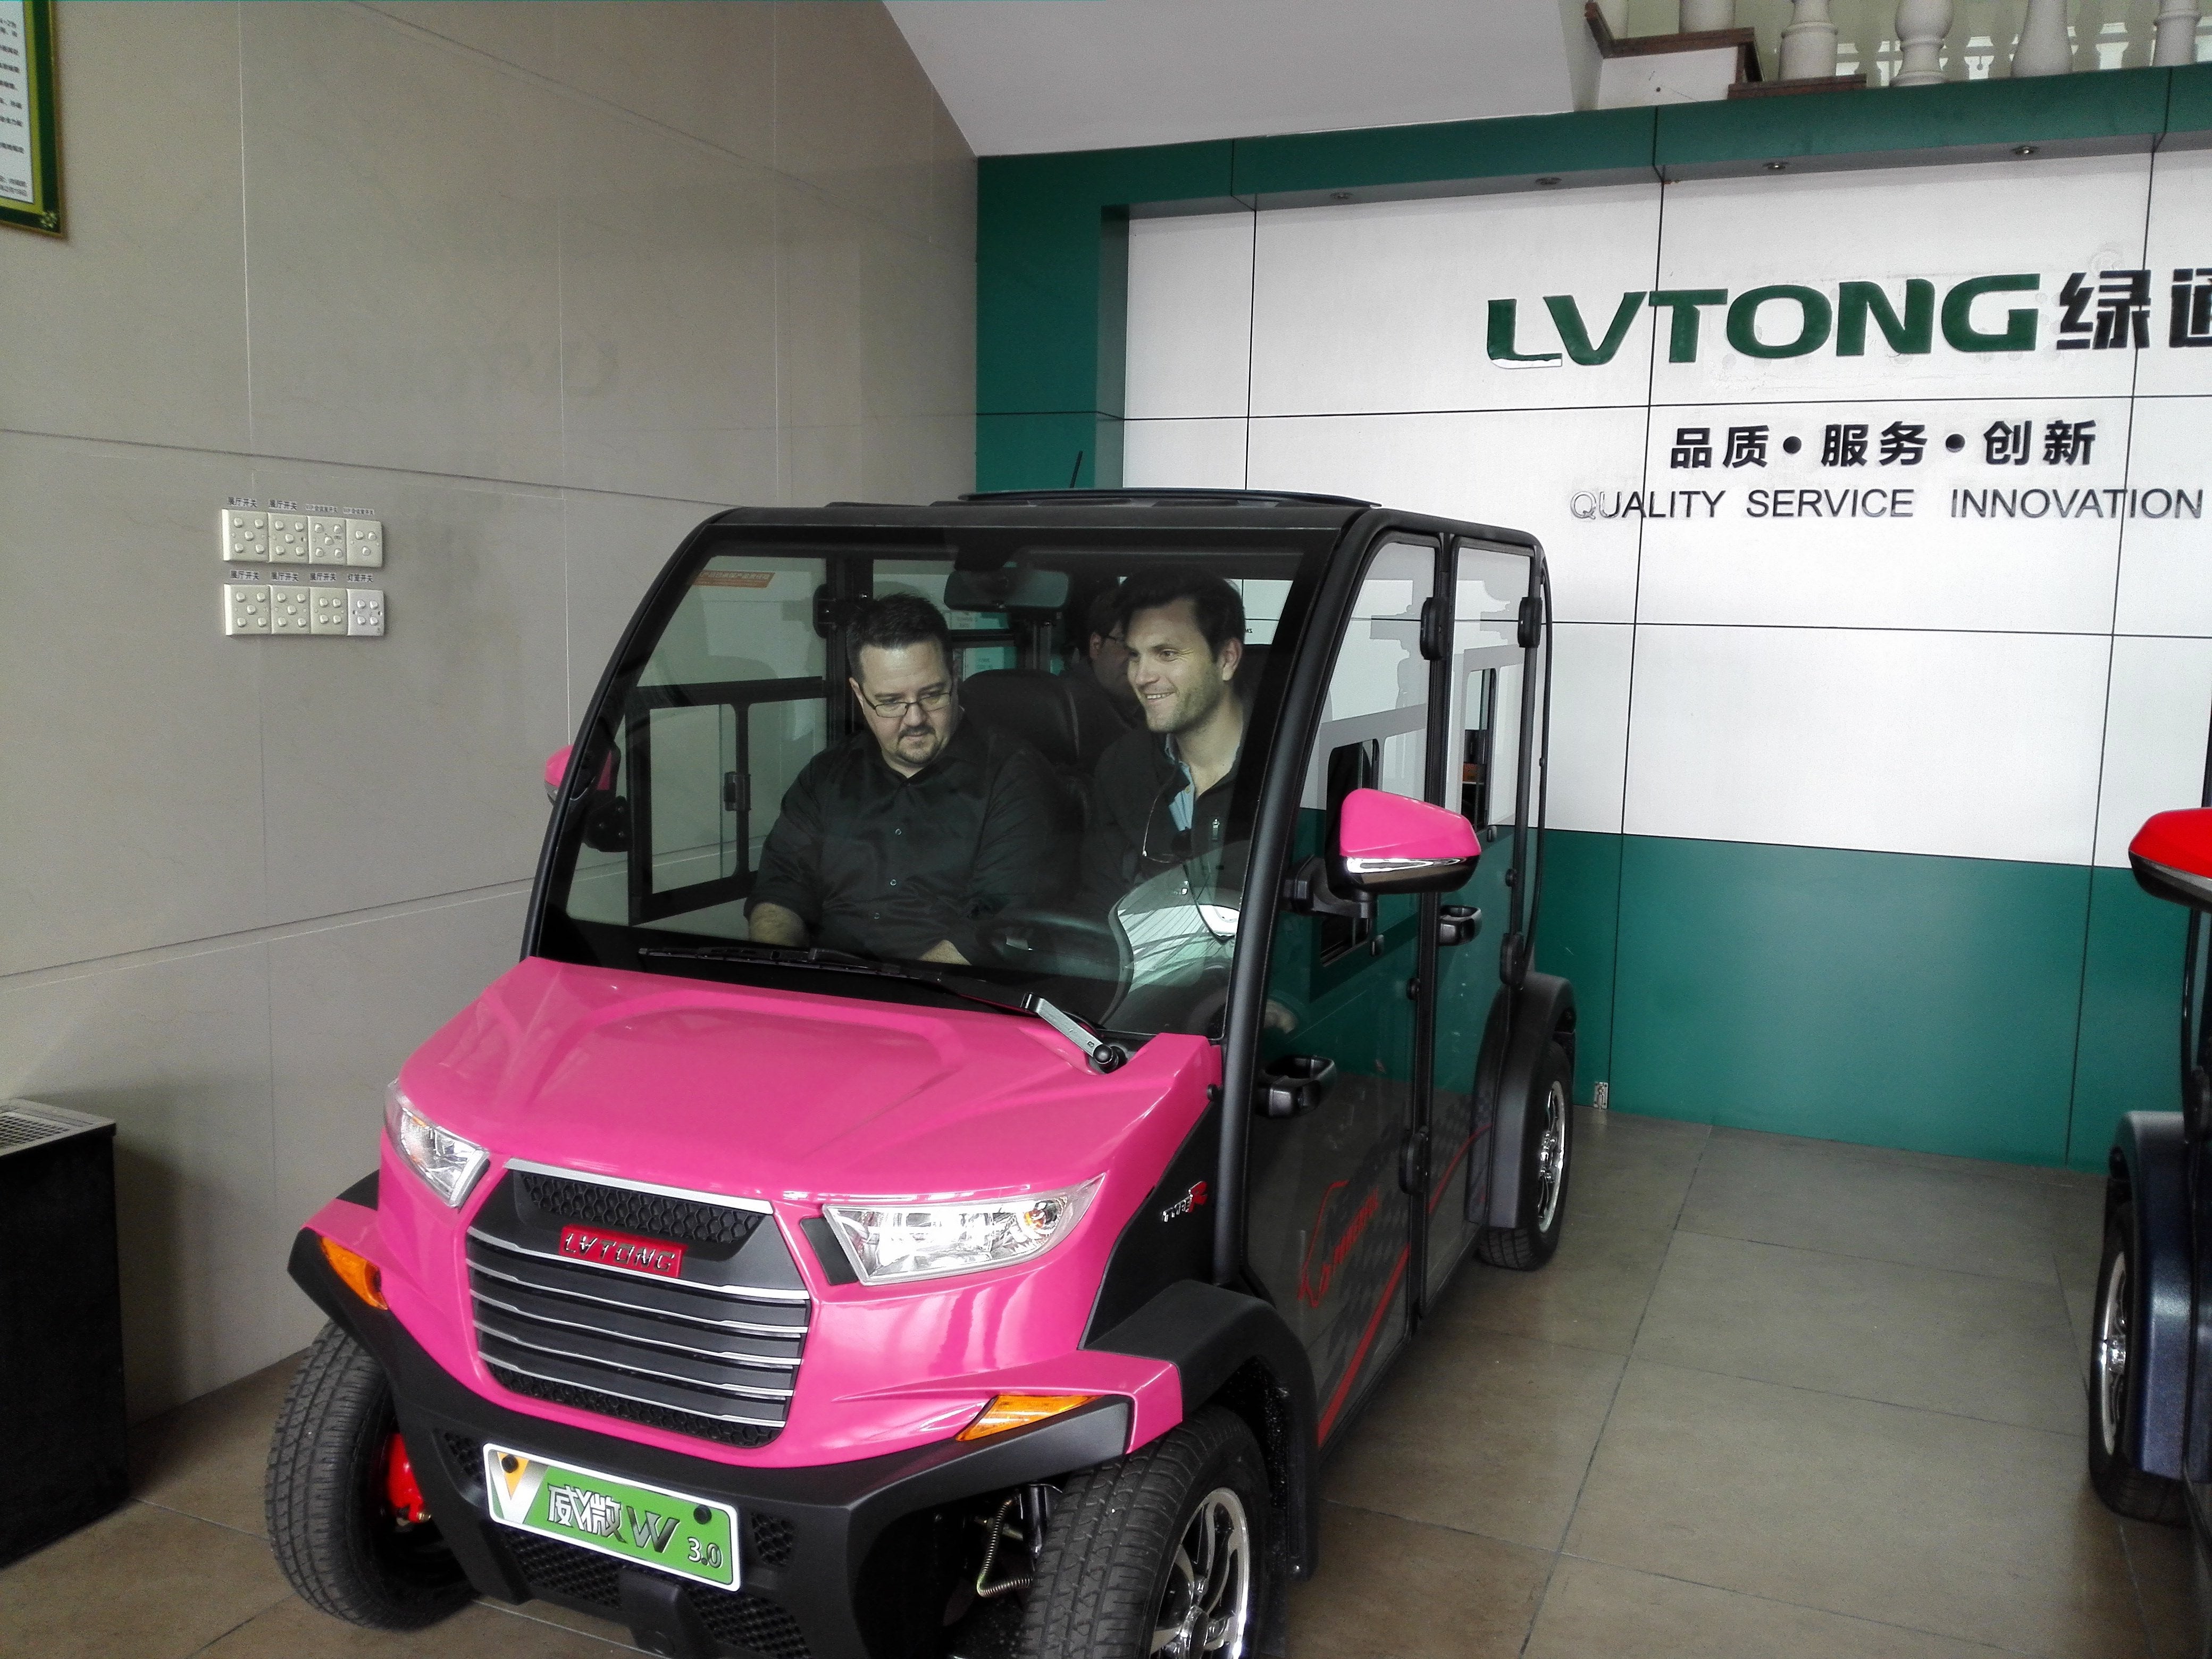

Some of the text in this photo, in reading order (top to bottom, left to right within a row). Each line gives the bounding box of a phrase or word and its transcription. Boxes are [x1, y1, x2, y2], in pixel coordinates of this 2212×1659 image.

[1487, 273, 2040, 369] LVTONG
[1570, 488, 2203, 520] QUALITY SERVICE INNOVATION
[565, 1233, 675, 1272] LVTONG
[686, 1536, 724, 1569] 3.0
